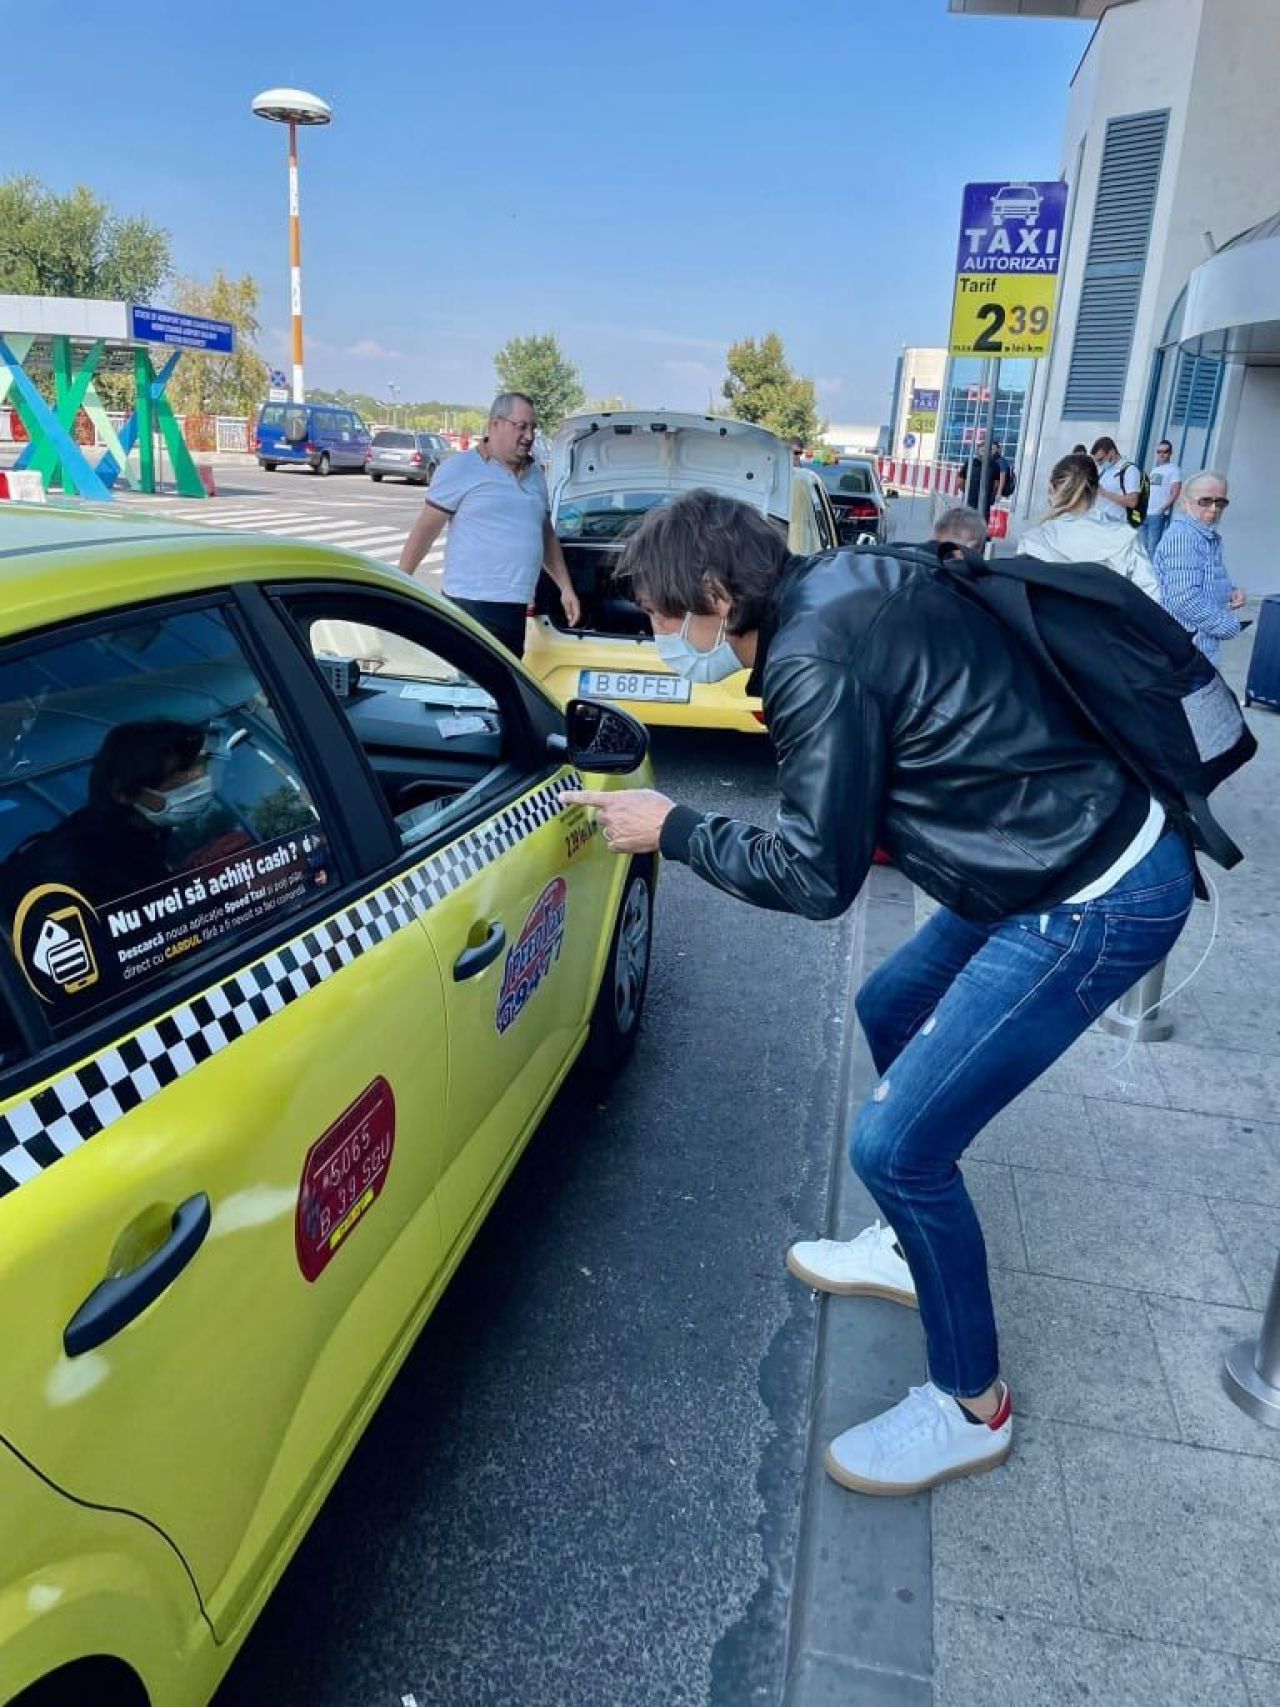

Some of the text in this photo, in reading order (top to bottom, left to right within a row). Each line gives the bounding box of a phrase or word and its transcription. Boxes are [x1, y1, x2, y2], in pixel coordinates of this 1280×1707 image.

[964, 227, 1057, 254] TAXI
[963, 257, 1058, 270] AUTORIZAT
[960, 277, 998, 293] Tarif
[596, 675, 681, 696] B 68 FET
[107, 909, 142, 938] Nu
[142, 887, 184, 922] vrei
[184, 878, 208, 905] să
[118, 931, 165, 962] Descarcă
[123, 959, 152, 980] direct
[152, 953, 165, 966] cu
